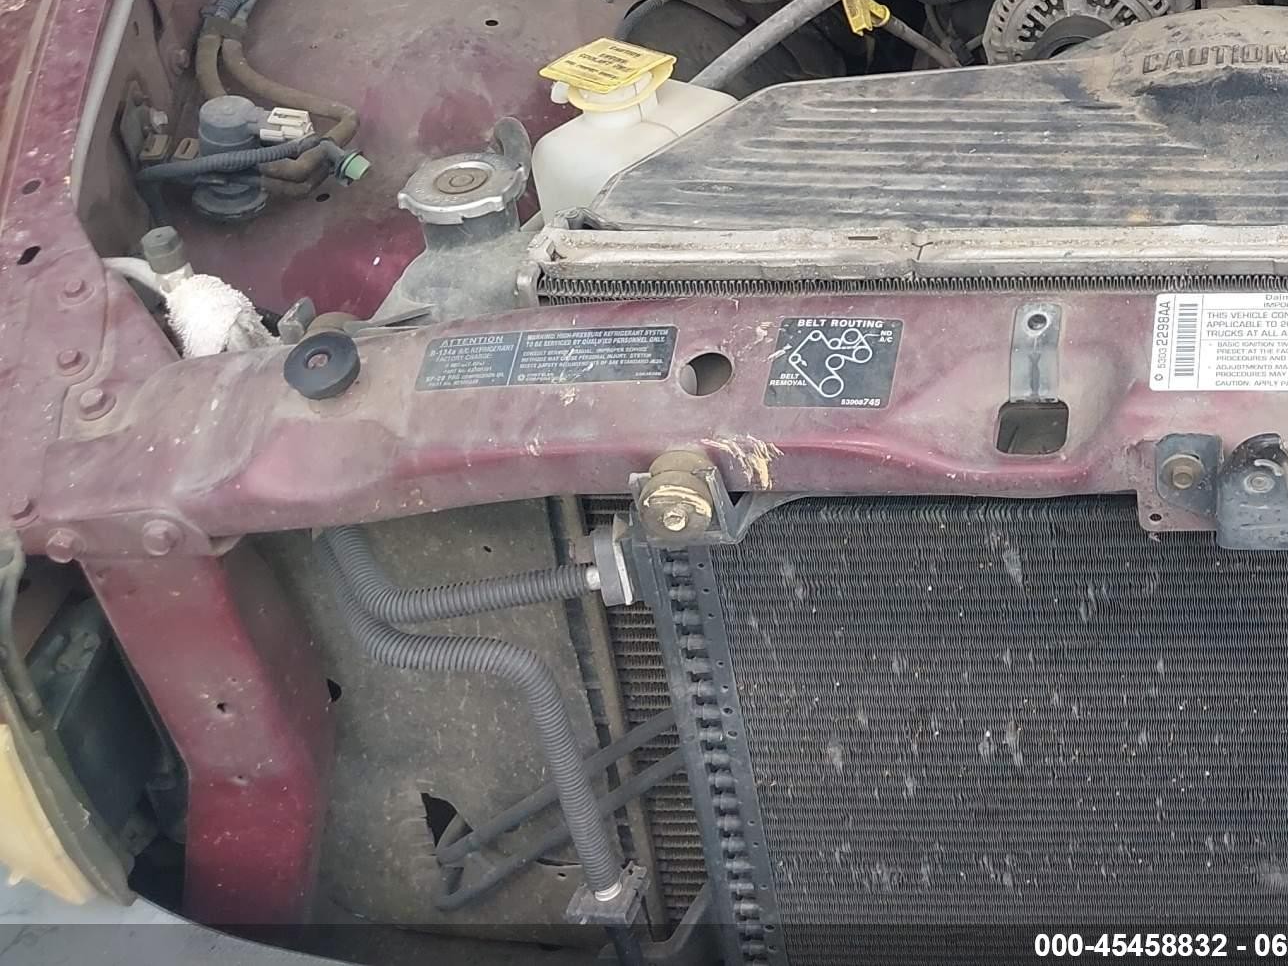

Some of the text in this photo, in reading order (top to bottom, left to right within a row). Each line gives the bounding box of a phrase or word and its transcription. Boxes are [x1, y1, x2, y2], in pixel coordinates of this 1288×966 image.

[1207, 311, 1228, 319] THIS
[1230, 311, 1268, 319] VEHICLE
[797, 319, 884, 328] BELT ROUTING
[1206, 320, 1262, 328] APPLICABLE
[1266, 320, 1277, 328] TO
[1207, 329, 1242, 337] TRUCKS
[1247, 329, 1262, 337] AT
[1265, 329, 1280, 337] ALL
[441, 335, 504, 347] ATTENTION
[470, 344, 515, 354] REFRIGERANT
